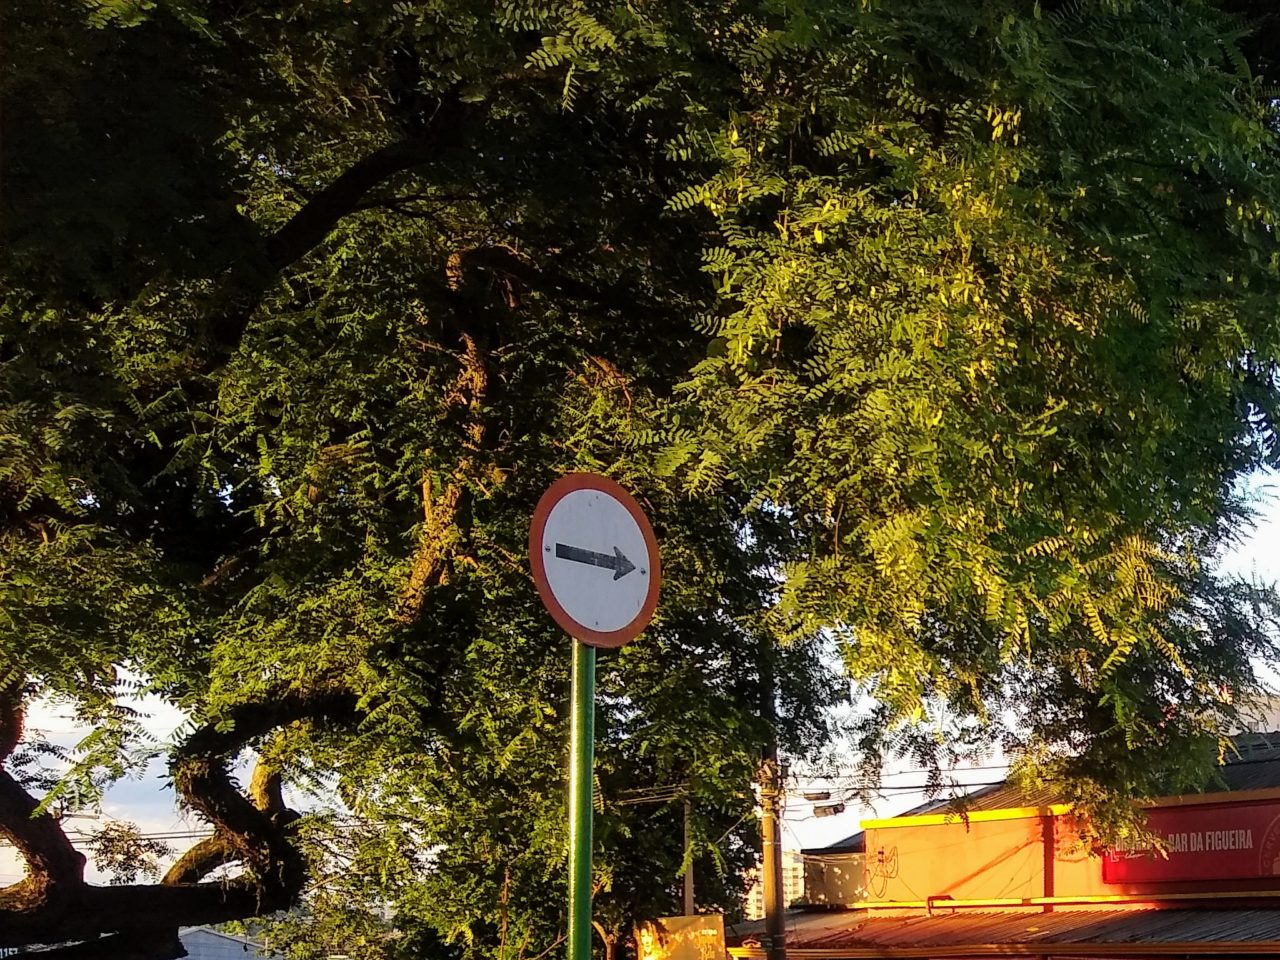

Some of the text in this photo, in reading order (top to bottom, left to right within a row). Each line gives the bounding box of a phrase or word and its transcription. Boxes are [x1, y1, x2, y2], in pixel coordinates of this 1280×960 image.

[1168, 832, 1188, 853] BAR
[1190, 832, 1205, 852] DA
[1205, 829, 1254, 851] FIGUEIRA
